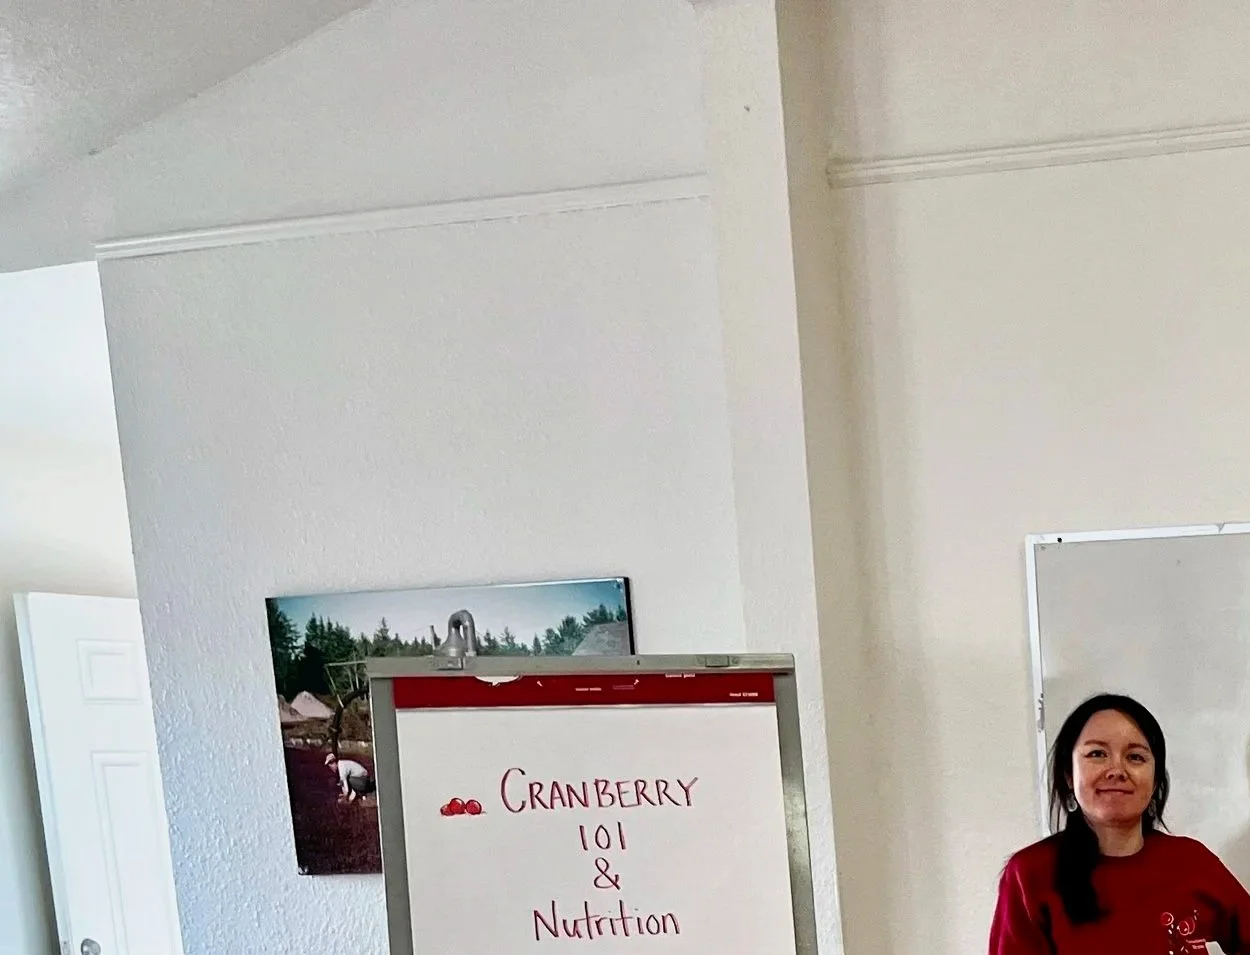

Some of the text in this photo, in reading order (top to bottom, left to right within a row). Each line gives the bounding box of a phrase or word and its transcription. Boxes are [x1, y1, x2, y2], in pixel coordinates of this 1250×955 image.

[502, 768, 699, 813] CRANBERRY
[579, 821, 627, 851] 101
[594, 857, 622, 891] &
[534, 900, 681, 942] Nutrition
